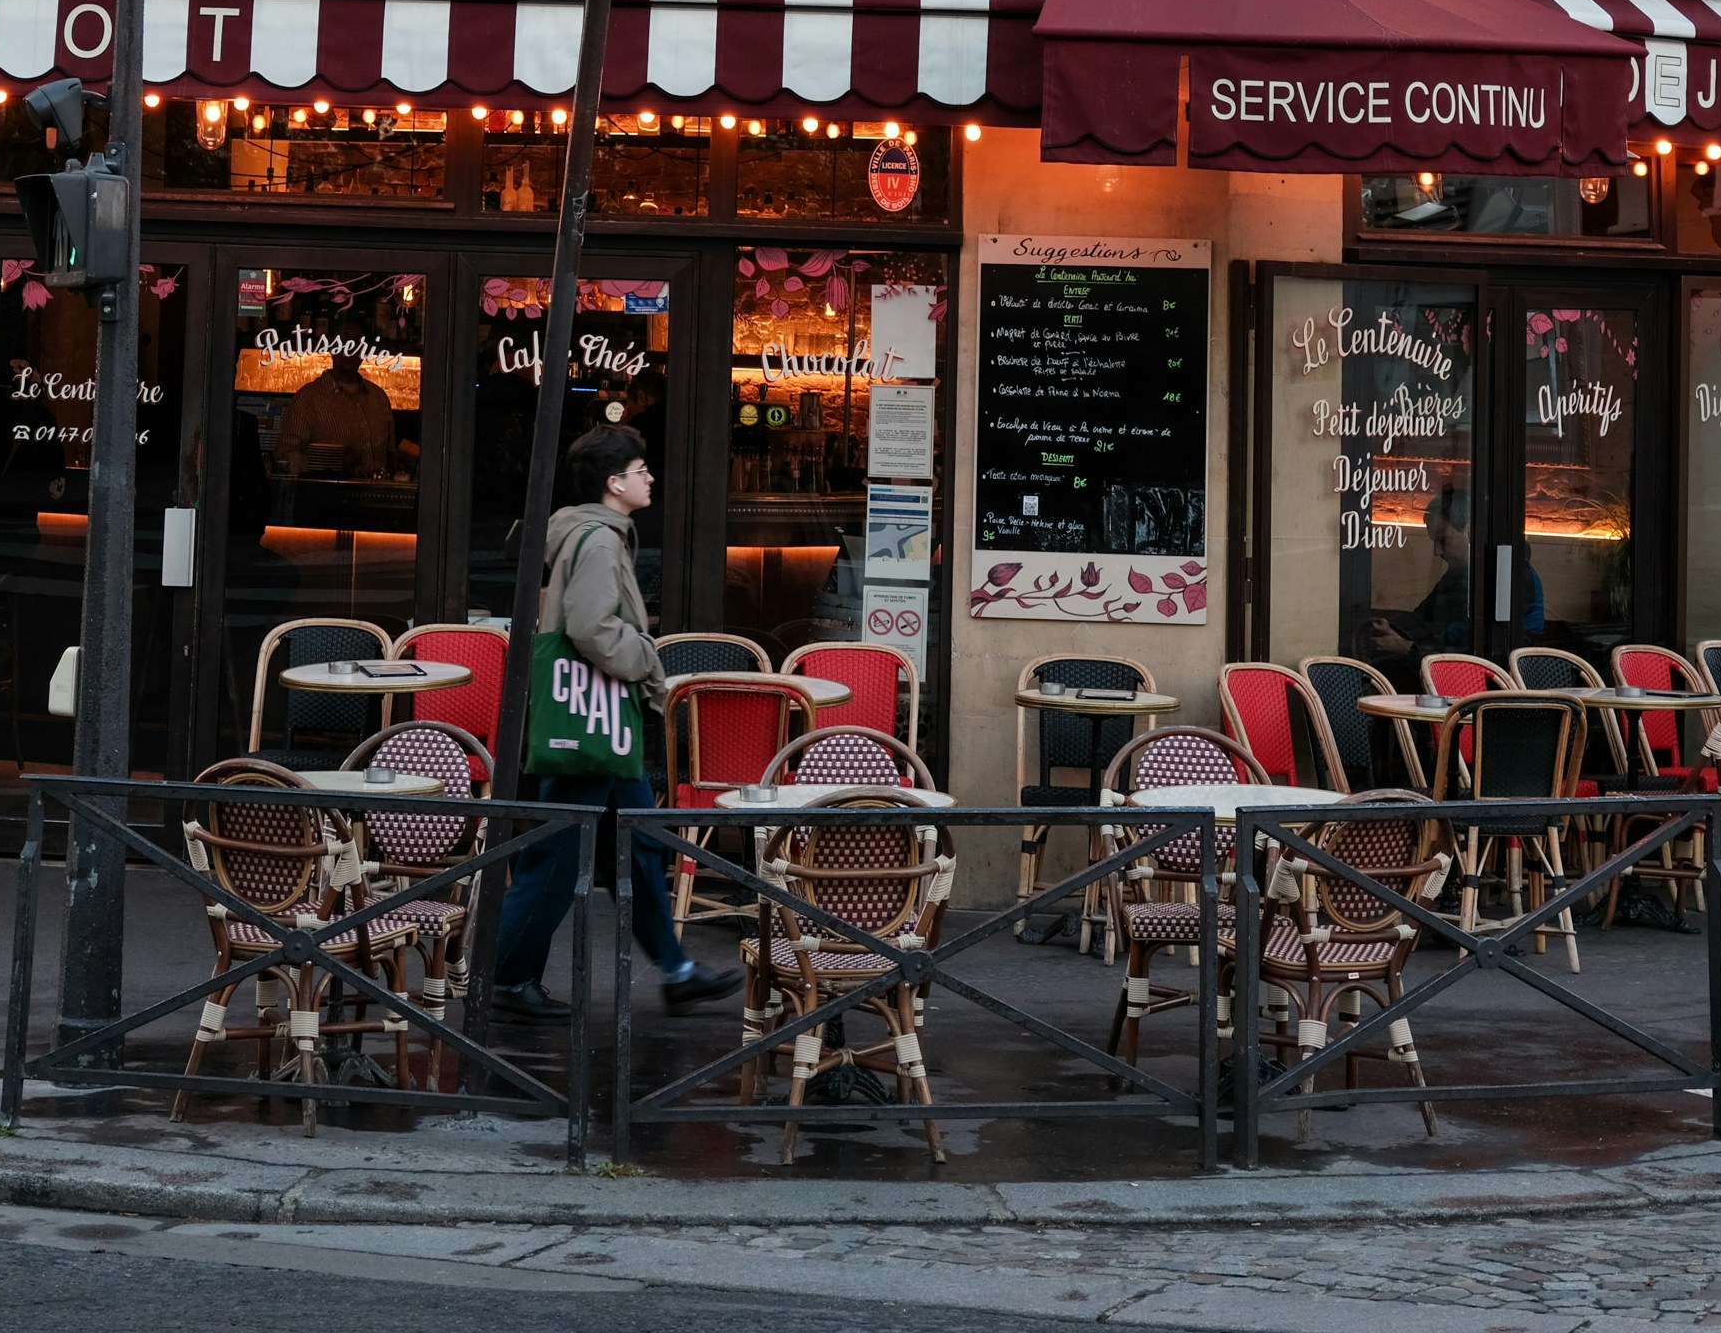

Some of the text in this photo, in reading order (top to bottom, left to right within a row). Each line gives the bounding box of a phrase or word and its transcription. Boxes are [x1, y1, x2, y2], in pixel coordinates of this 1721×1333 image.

[1209, 76, 1548, 131] SERVICE CONTINU
[871, 145, 887, 170] VILLE
[902, 146, 917, 172] PARIS
[881, 161, 907, 170] LICENCE
[887, 176, 900, 190] IV
[1013, 237, 1147, 264] Suggestions
[240, 282, 266, 290] Alarme
[497, 329, 651, 387] Caf Thés
[761, 339, 905, 384] Chocolat
[1292, 305, 1454, 382] Le Centenaire
[10, 366, 165, 405] Le Centre
[1163, 392, 1182, 403] 18€
[1394, 380, 1467, 421] Bières
[1312, 398, 1447, 455] Petit déjeuner
[1537, 381, 1623, 438] Apéritifs
[34, 425, 151, 445] 01 47 6
[1073, 475, 1088, 489] 8€
[1332, 453, 1431, 510] Déjeuner
[1341, 510, 1408, 551] Dîner
